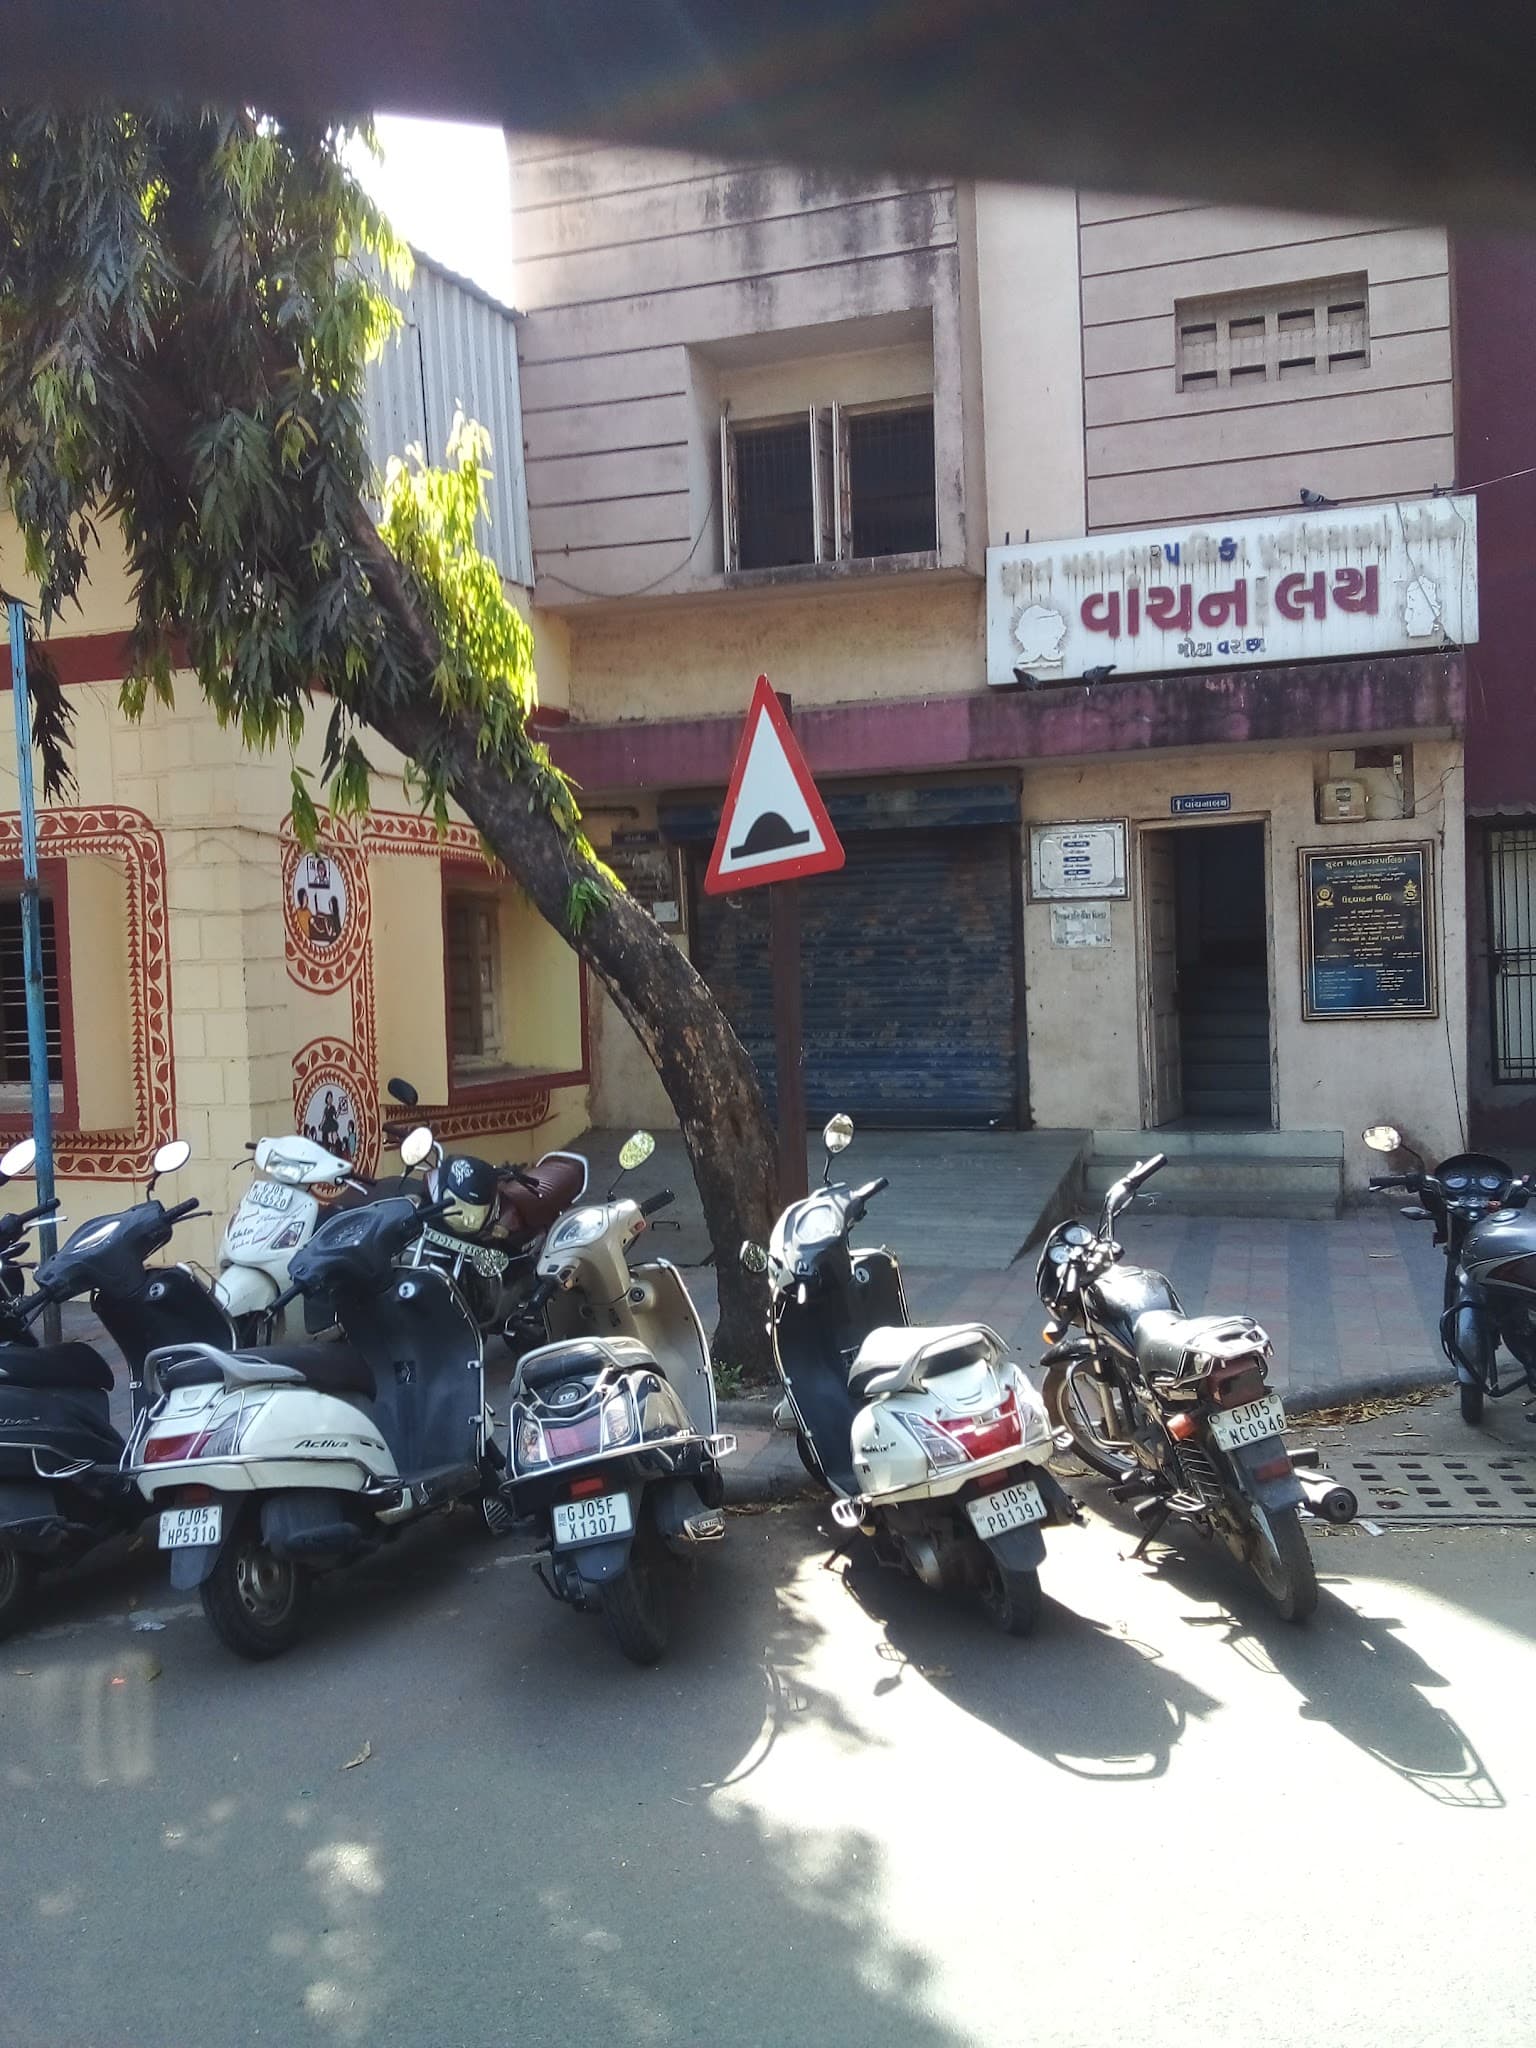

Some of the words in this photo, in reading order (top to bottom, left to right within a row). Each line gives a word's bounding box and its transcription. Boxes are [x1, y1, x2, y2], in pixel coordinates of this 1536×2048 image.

[1232, 1399, 1269, 1425] GJ05
[294, 1439, 349, 1449] Activa
[567, 1497, 613, 1522] GJ05F
[990, 1486, 1027, 1512] GJ05
[178, 1508, 209, 1527] GJ05
[569, 1515, 616, 1540] X1307
[987, 1500, 1043, 1533] PB1391
[167, 1525, 216, 1545] HP5310
